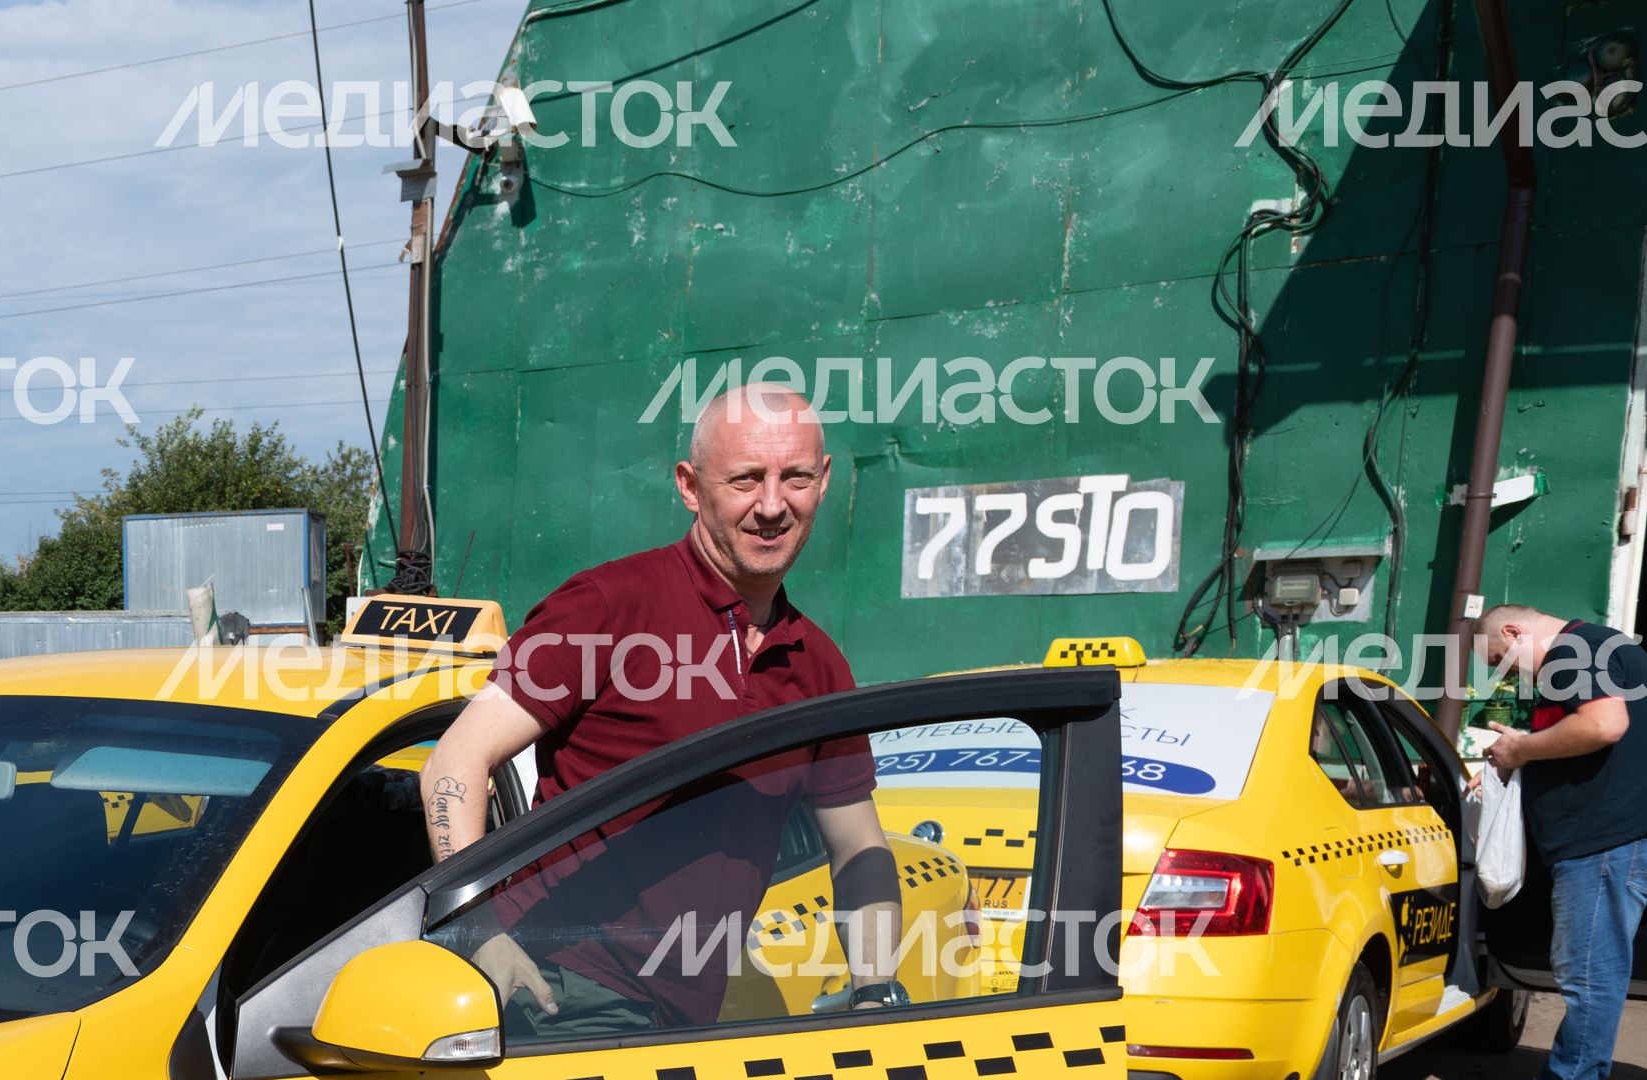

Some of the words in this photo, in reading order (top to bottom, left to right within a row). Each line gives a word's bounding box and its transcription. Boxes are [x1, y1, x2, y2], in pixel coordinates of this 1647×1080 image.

[380, 606, 457, 635] TAXI
[870, 721, 1028, 744] ПУТЕВЫЕ
[984, 877, 1017, 899] 77
[983, 900, 1008, 909] RUS
[1413, 902, 1457, 946] РЕЗИДЕ
